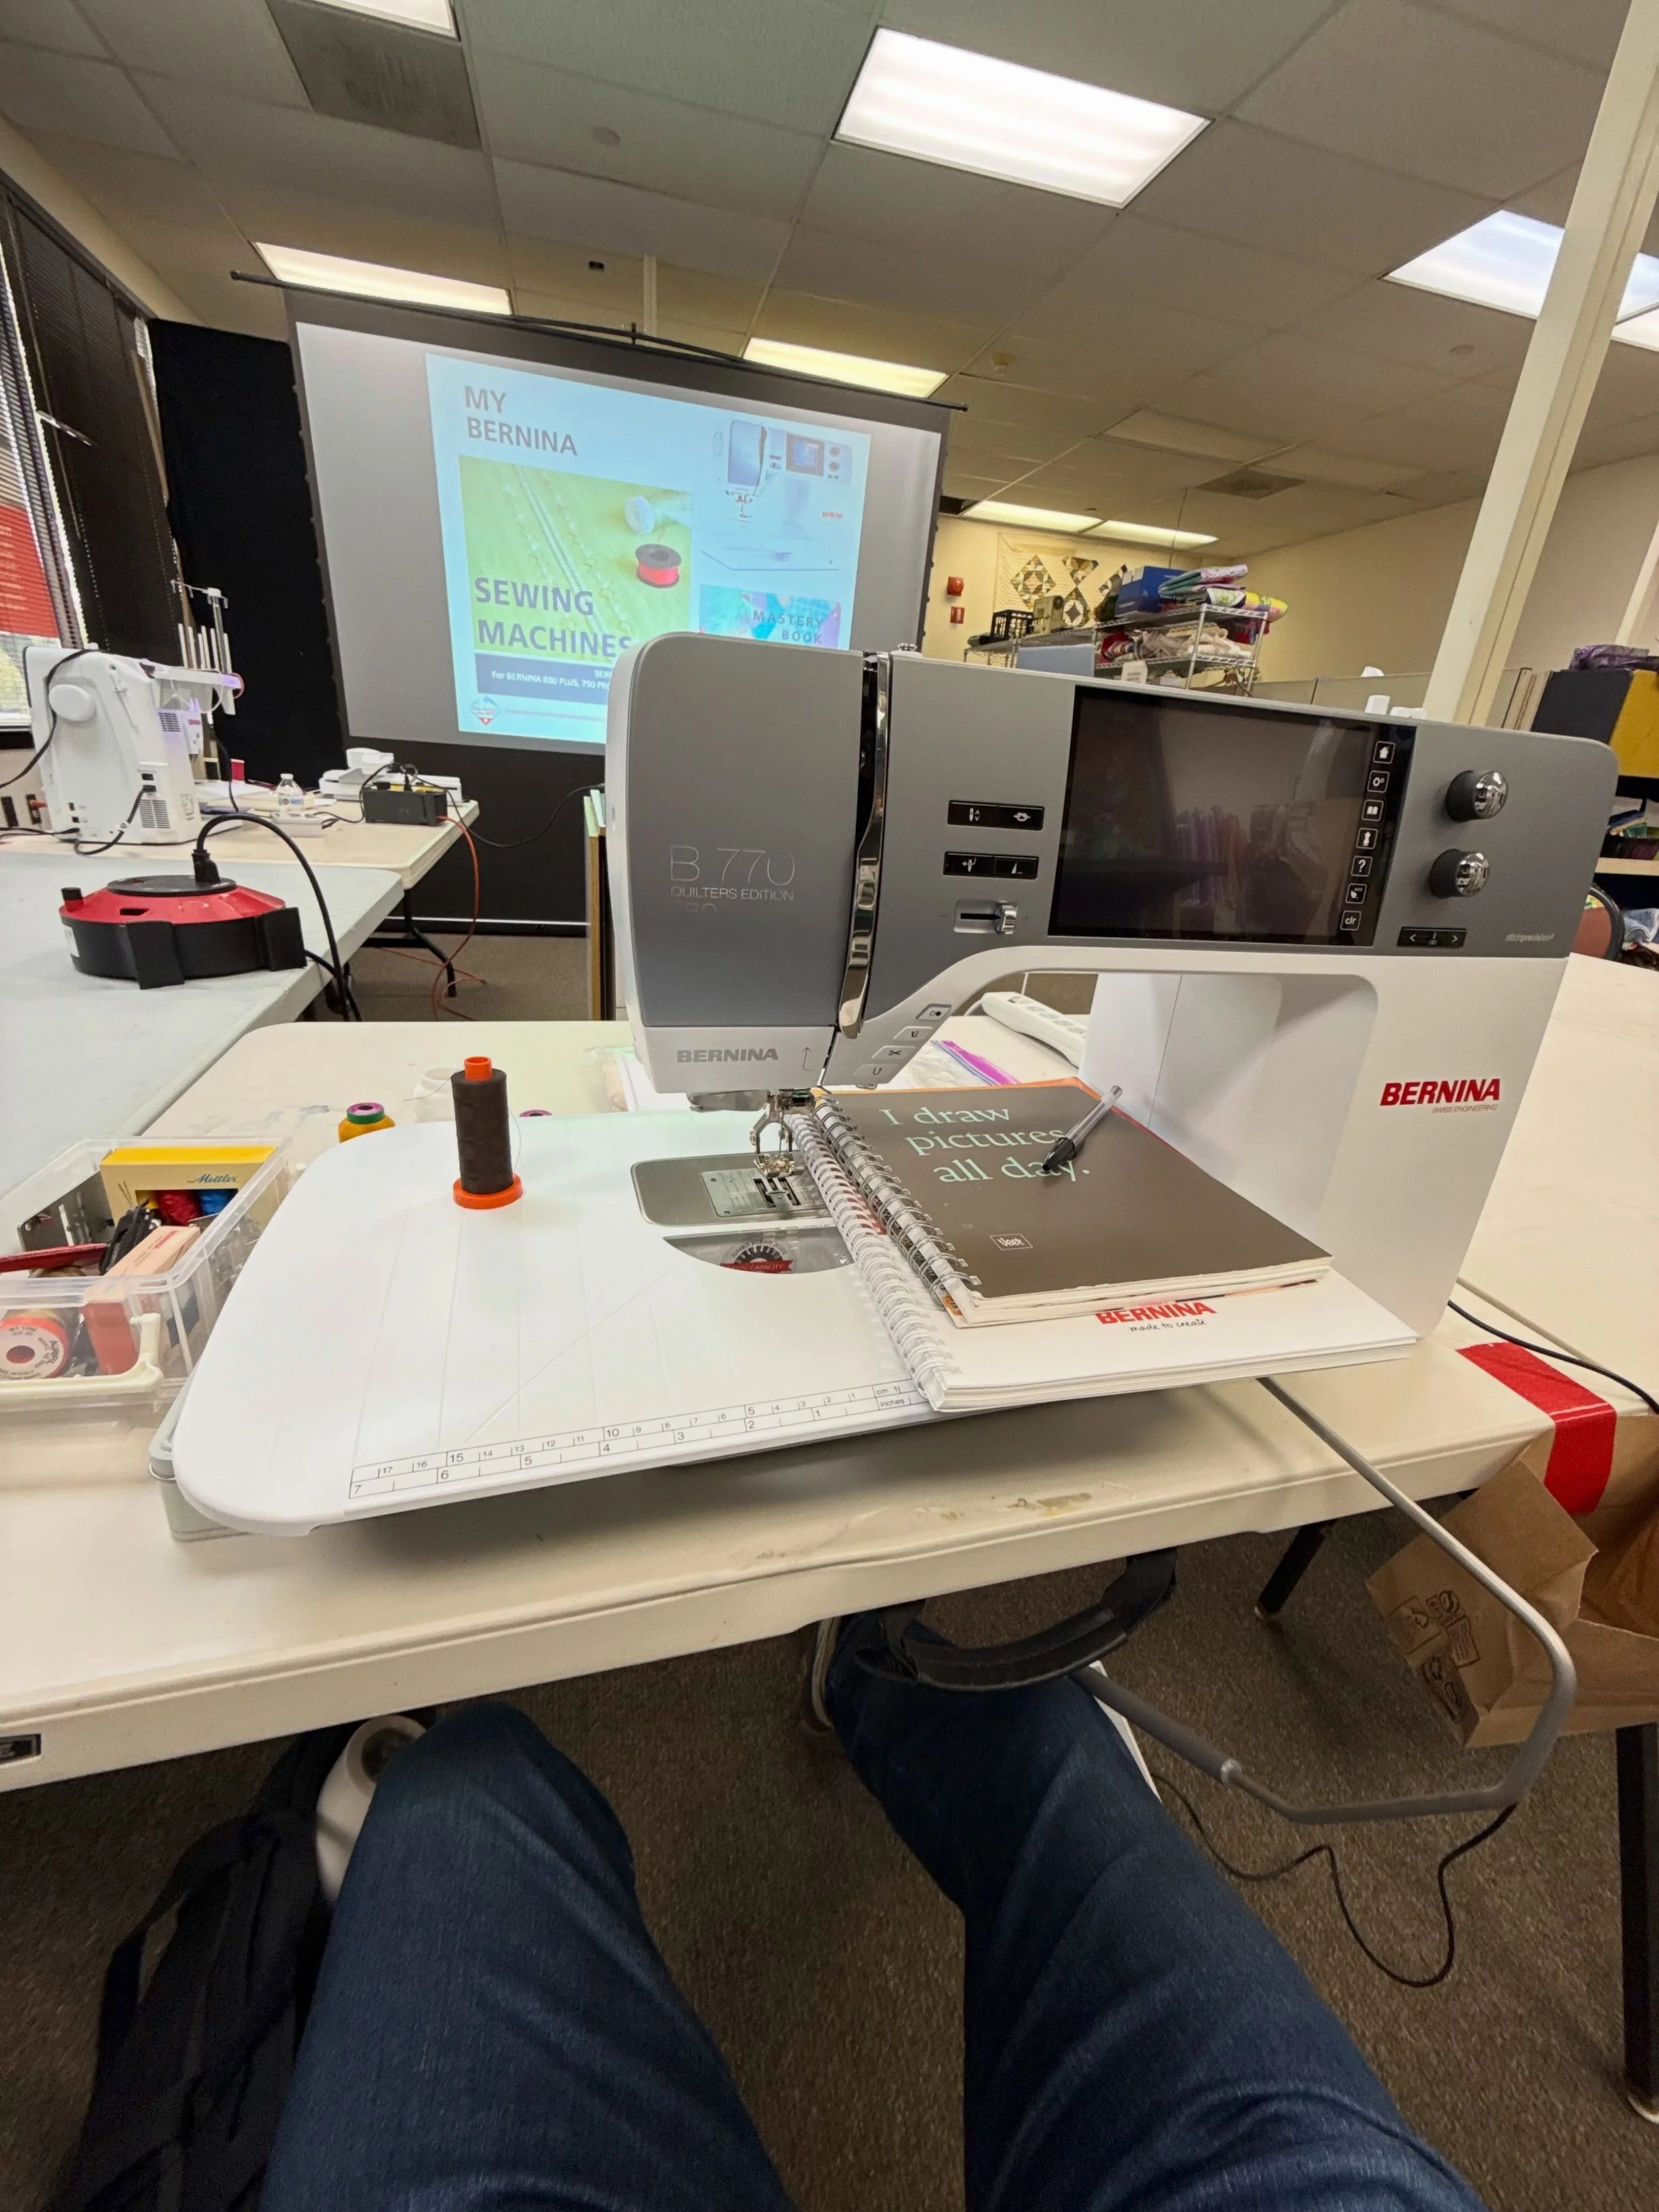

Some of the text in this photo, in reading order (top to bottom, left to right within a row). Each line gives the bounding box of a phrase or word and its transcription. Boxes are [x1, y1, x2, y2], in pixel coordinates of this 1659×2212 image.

[465, 385, 506, 413] MY
[467, 417, 578, 456] BERNINA
[474, 577, 593, 616] SEWING
[753, 610, 824, 628] MASTERY
[782, 630, 822, 644] BOOK
[506, 672, 541, 683] BERNINA
[670, 845, 795, 886] B 770
[670, 886, 794, 901] QUILTERS EDITION
[677, 1048, 779, 1063] BERNINA
[1380, 1078, 1500, 1106] BERNINA
[878, 1106, 1010, 1125] I draw
[1453, 1104, 1498, 1113] ENGINEERING
[186, 1173, 238, 1183] Mettler
[933, 1158, 994, 1182] all
[1095, 1301, 1218, 1325] BERNINA
[1129, 1323, 1158, 1333] made
[1176, 1318, 1207, 1328] create
[449, 1453, 464, 1463] 15
[606, 1428, 620, 1438] 10
[748, 1406, 755, 1415] 5
[354, 1485, 362, 1495] 7
[441, 1470, 449, 1480] 6
[525, 1455, 532, 1465] 5
[603, 1443, 611, 1453] 4
[678, 1432, 684, 1441] 3
[748, 1420, 755, 1429] 2
[880, 1398, 905, 1407] inches
